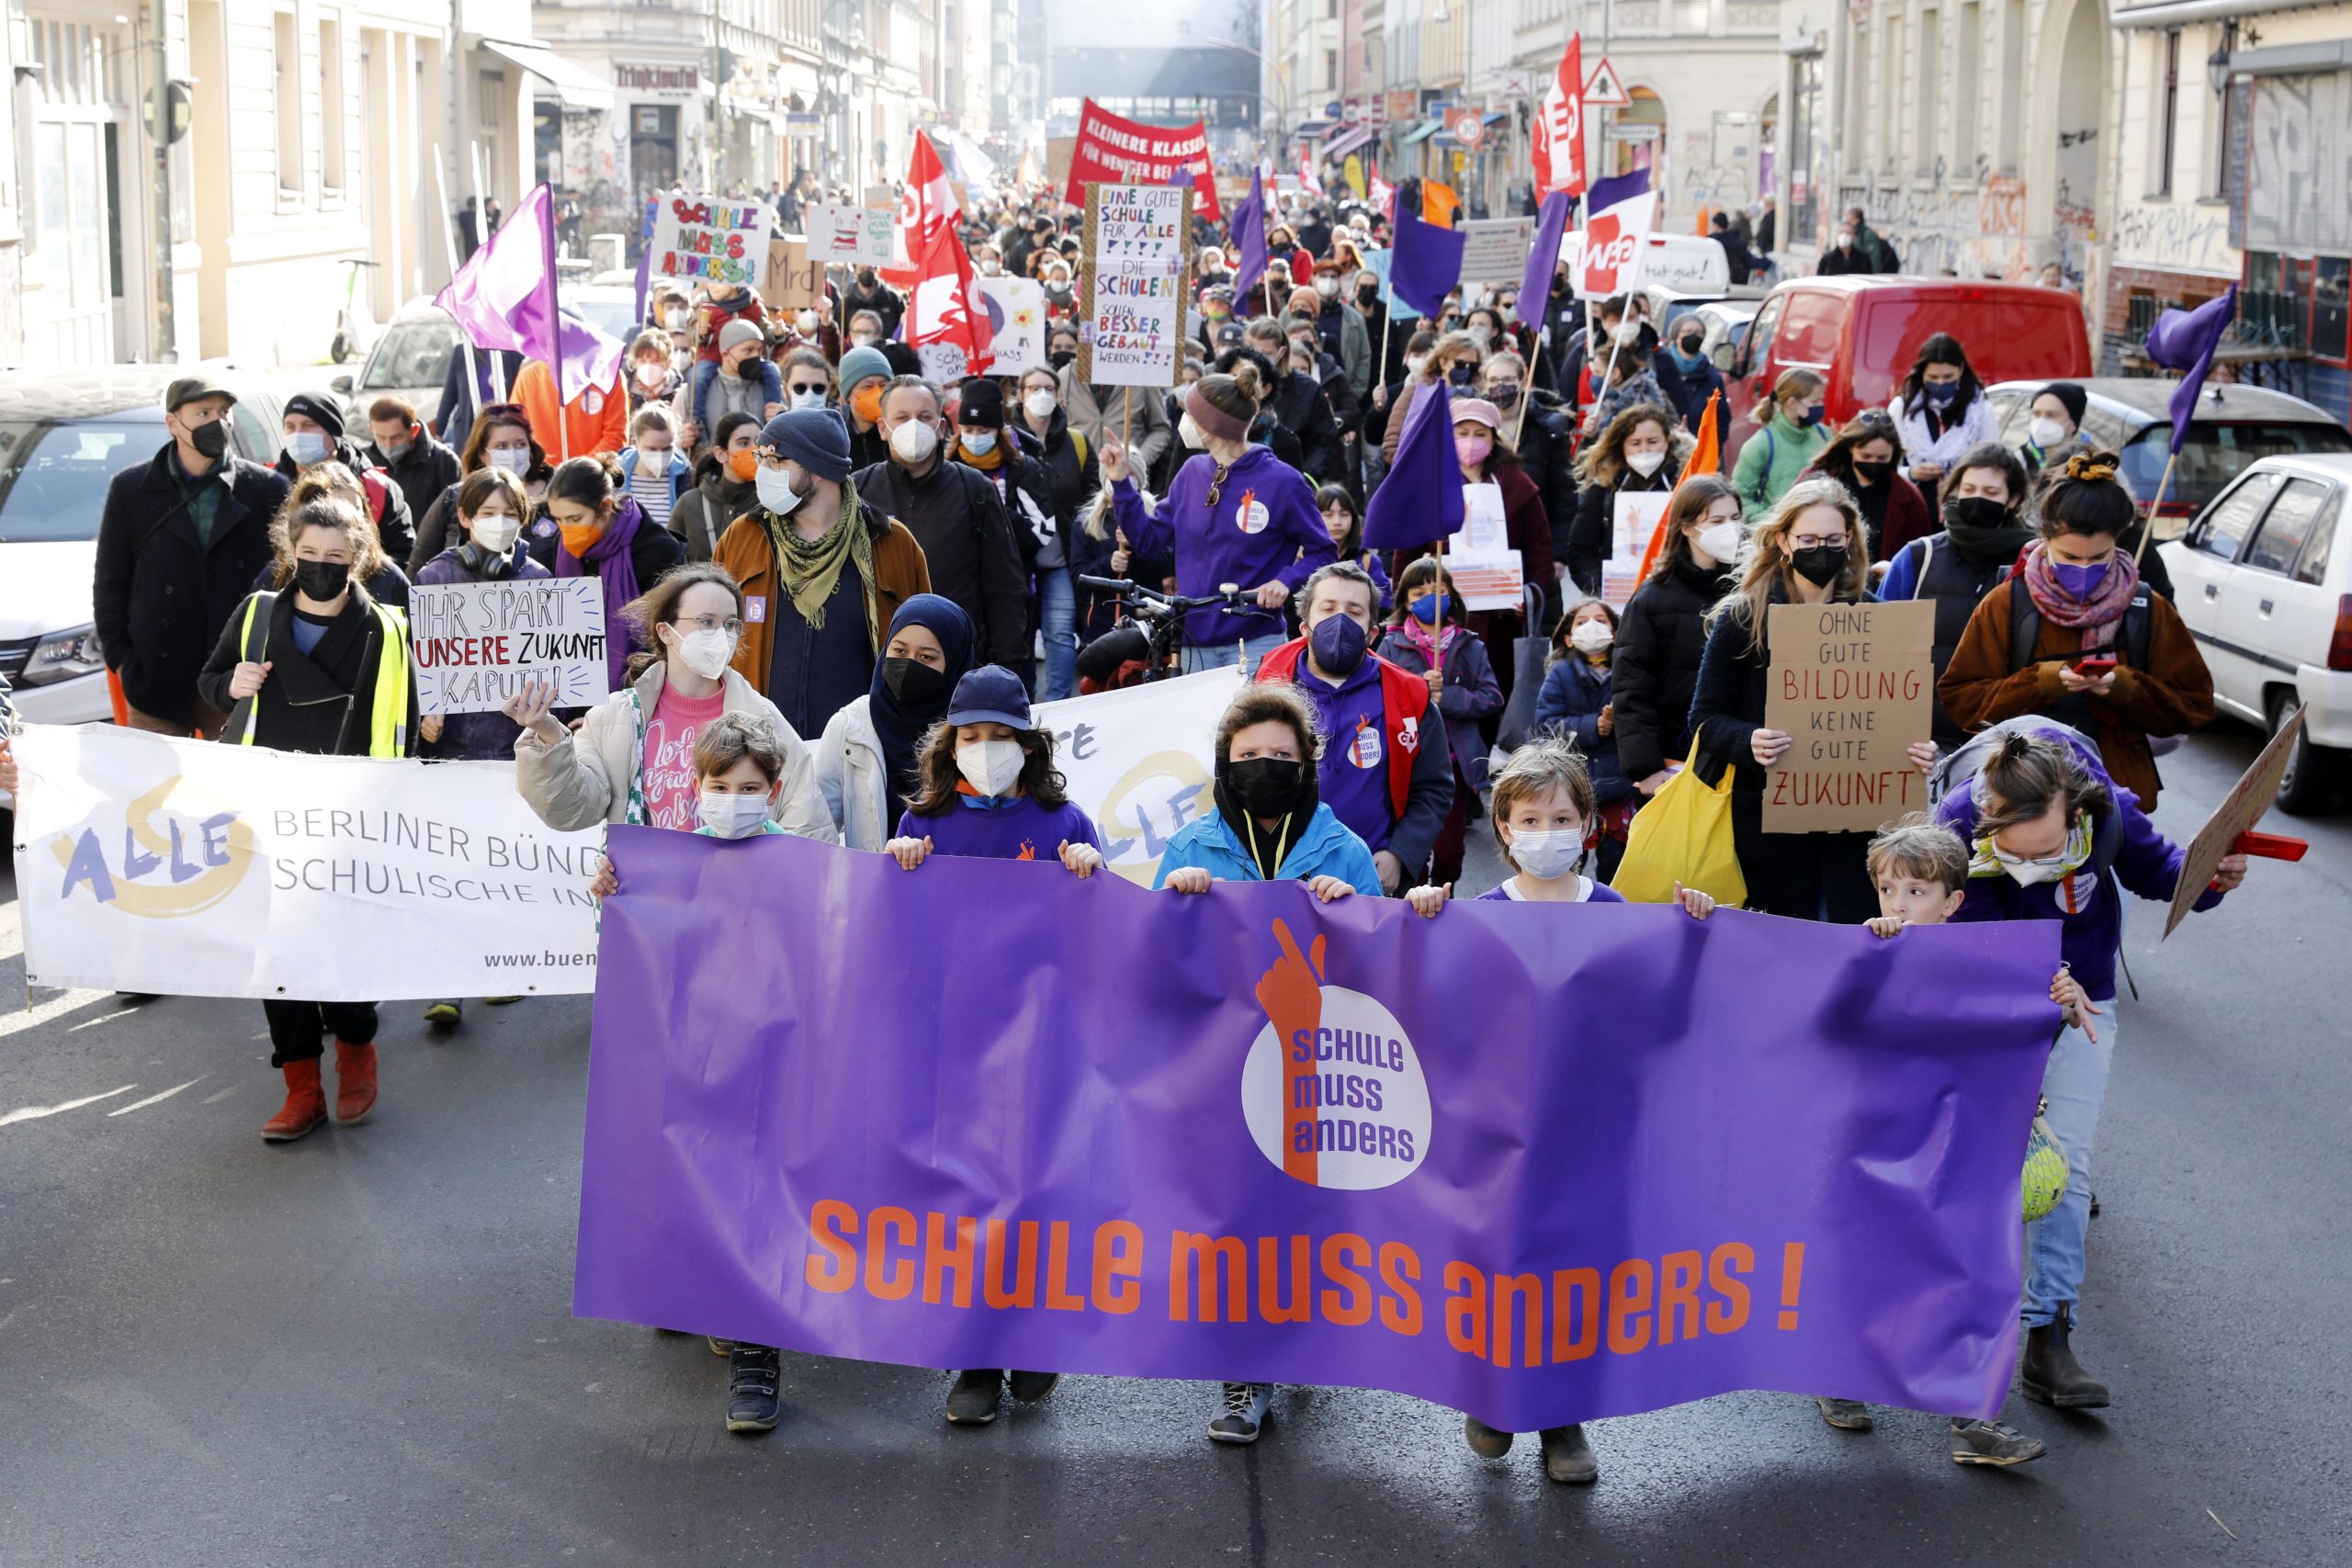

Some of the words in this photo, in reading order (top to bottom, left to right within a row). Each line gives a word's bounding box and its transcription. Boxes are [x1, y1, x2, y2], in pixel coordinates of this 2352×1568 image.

[1086, 117, 1148, 155] KLEINERE
[1082, 141, 1100, 164] FÜR
[1102, 188, 1136, 205] EINE
[1145, 190, 1180, 208] GUTE
[1102, 206, 1154, 223] SCHULE
[1103, 223, 1126, 238] FÜR
[1135, 224, 1175, 239] ALLE
[662, 251, 754, 284] ANDERS!
[1123, 260, 1146, 276] DIE
[1097, 275, 1174, 297] SCHULEN
[1100, 316, 1160, 333] BESSER
[1097, 334, 1160, 350] GEBAUT
[419, 592, 470, 639] IHR
[478, 588, 571, 632] SPART
[1819, 612, 1872, 636] OHNE
[416, 636, 510, 669] UNSERE
[517, 632, 605, 664] ZUKUNFT
[1819, 643, 1871, 664] GUTE
[1783, 669, 1920, 701] BILDUNG
[1811, 711, 1875, 732] KEINE
[1811, 740, 1868, 761] GUTE
[1772, 772, 1916, 807] ZUKUNFT
[274, 808, 470, 862] BERLINER
[62, 810, 241, 904] ALLE
[274, 858, 540, 904] SCHULISCHE
